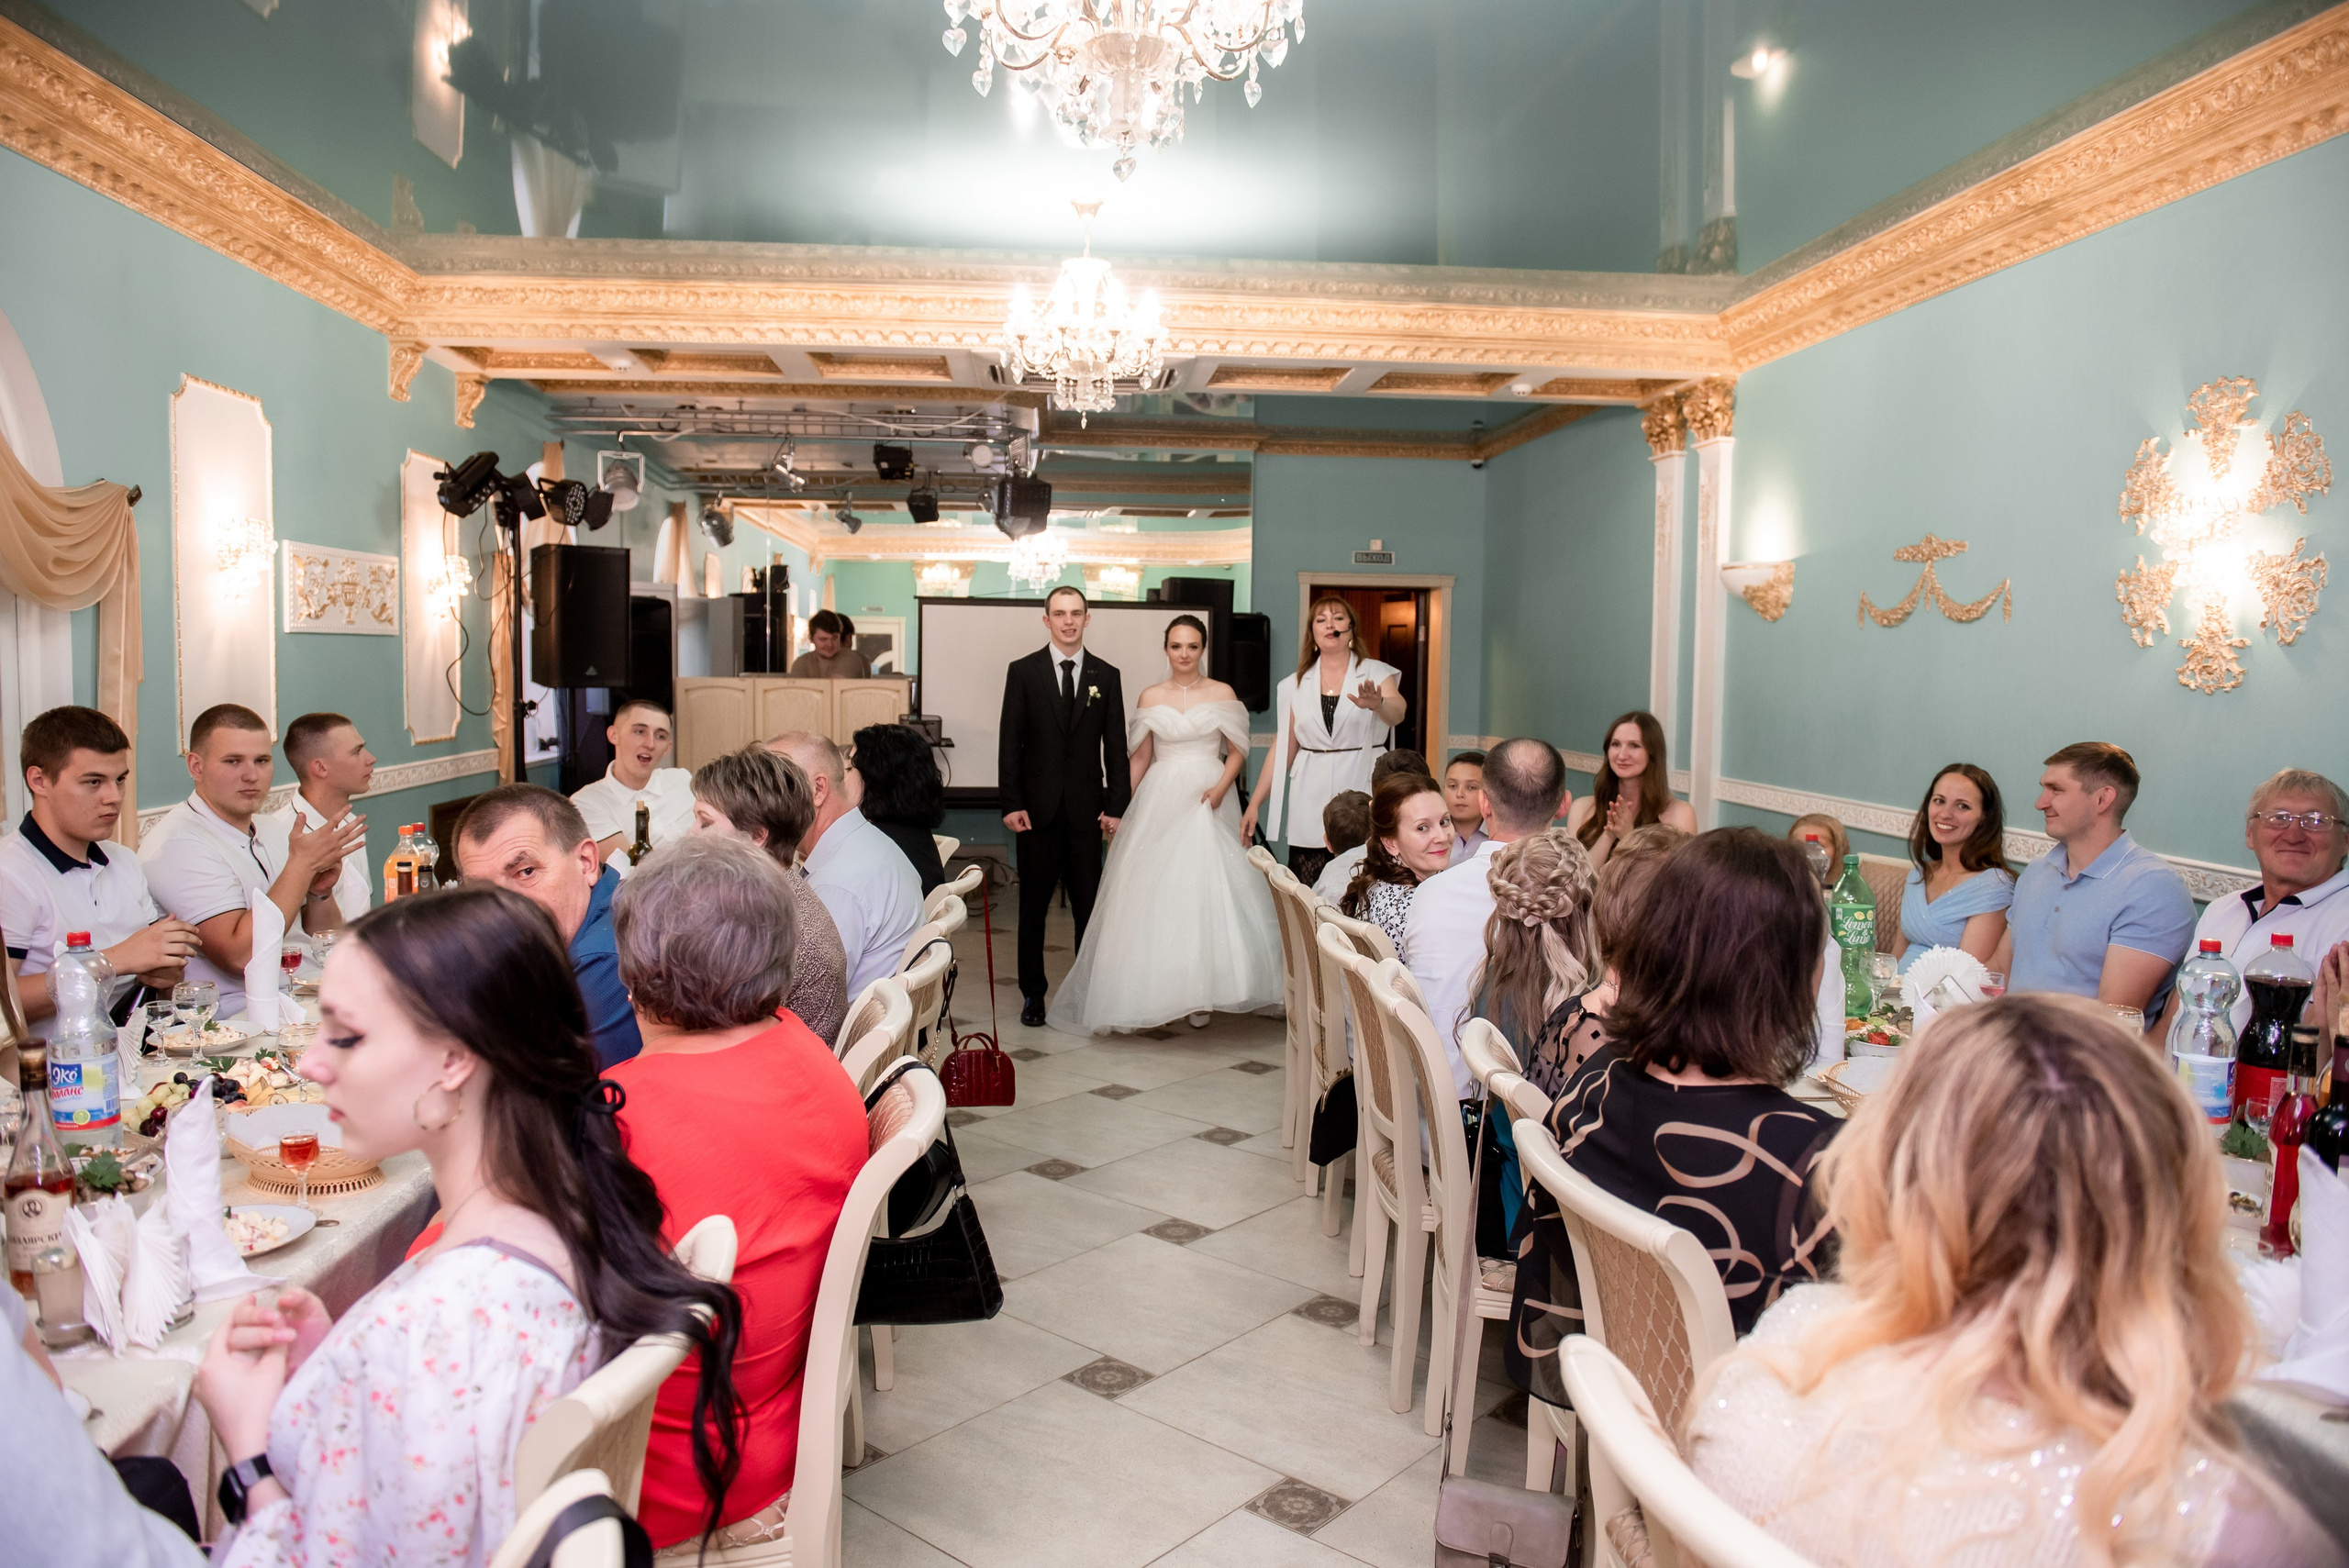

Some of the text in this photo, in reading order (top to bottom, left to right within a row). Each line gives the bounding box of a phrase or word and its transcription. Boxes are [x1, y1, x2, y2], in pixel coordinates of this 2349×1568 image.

[1355, 553, 1391, 562] ВЫХОД
[1840, 917, 1873, 931] Lemon
[1843, 930, 1871, 945] Lime
